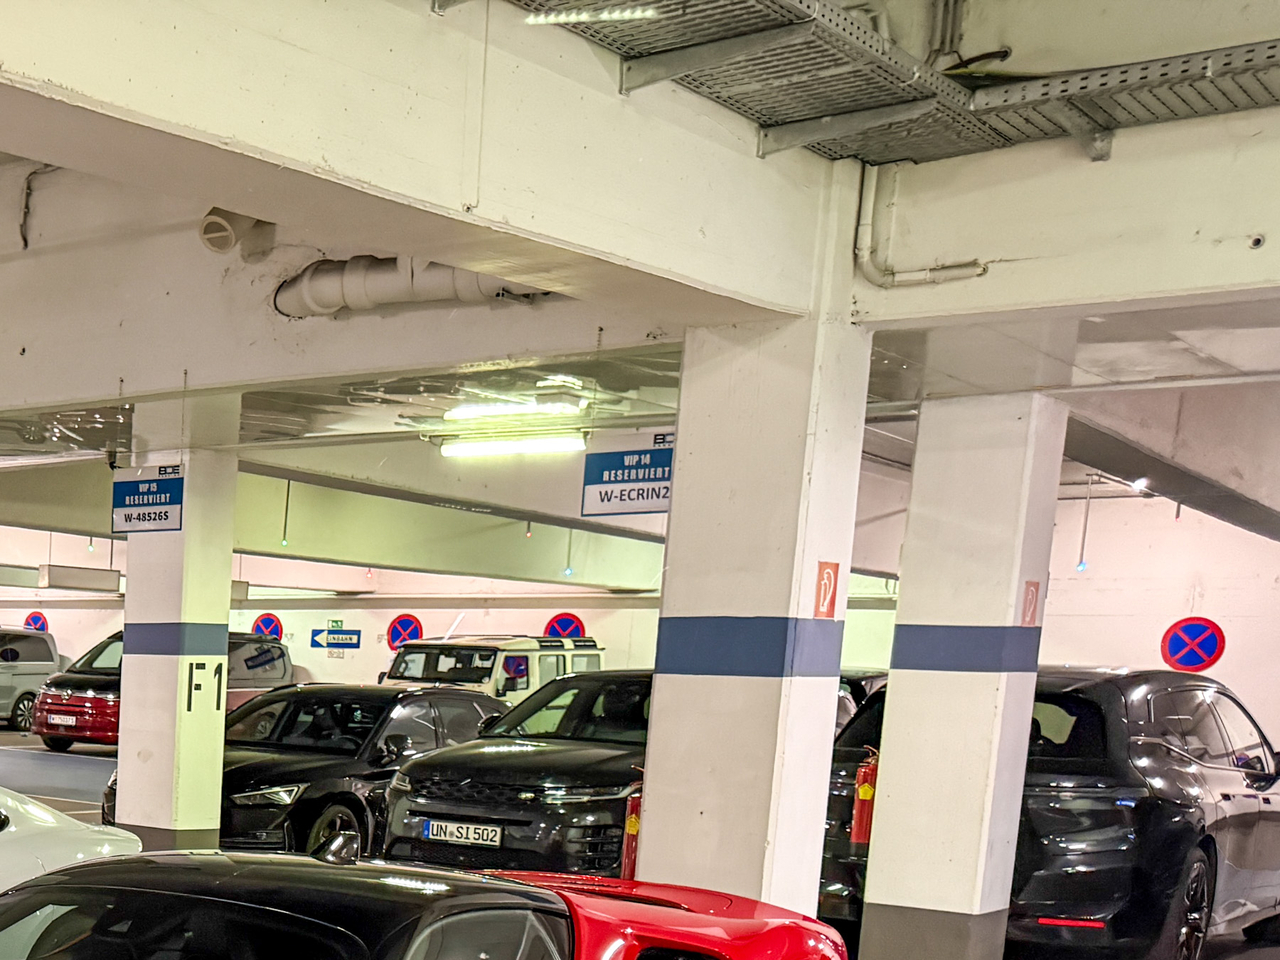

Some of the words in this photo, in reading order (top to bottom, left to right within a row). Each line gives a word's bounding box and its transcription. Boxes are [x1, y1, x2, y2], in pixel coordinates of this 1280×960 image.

[623, 454, 640, 466] VIP
[640, 453, 651, 465] 14
[602, 467, 670, 481] RESERVIERT
[138, 483, 149, 492] VIP
[125, 493, 170, 505] RESERVIERT
[599, 486, 670, 503] W-ECRIN2
[124, 511, 169, 523] W-48526S
[431, 823, 448, 838] UN
[455, 825, 470, 840] SI
[473, 827, 497, 843] 502
